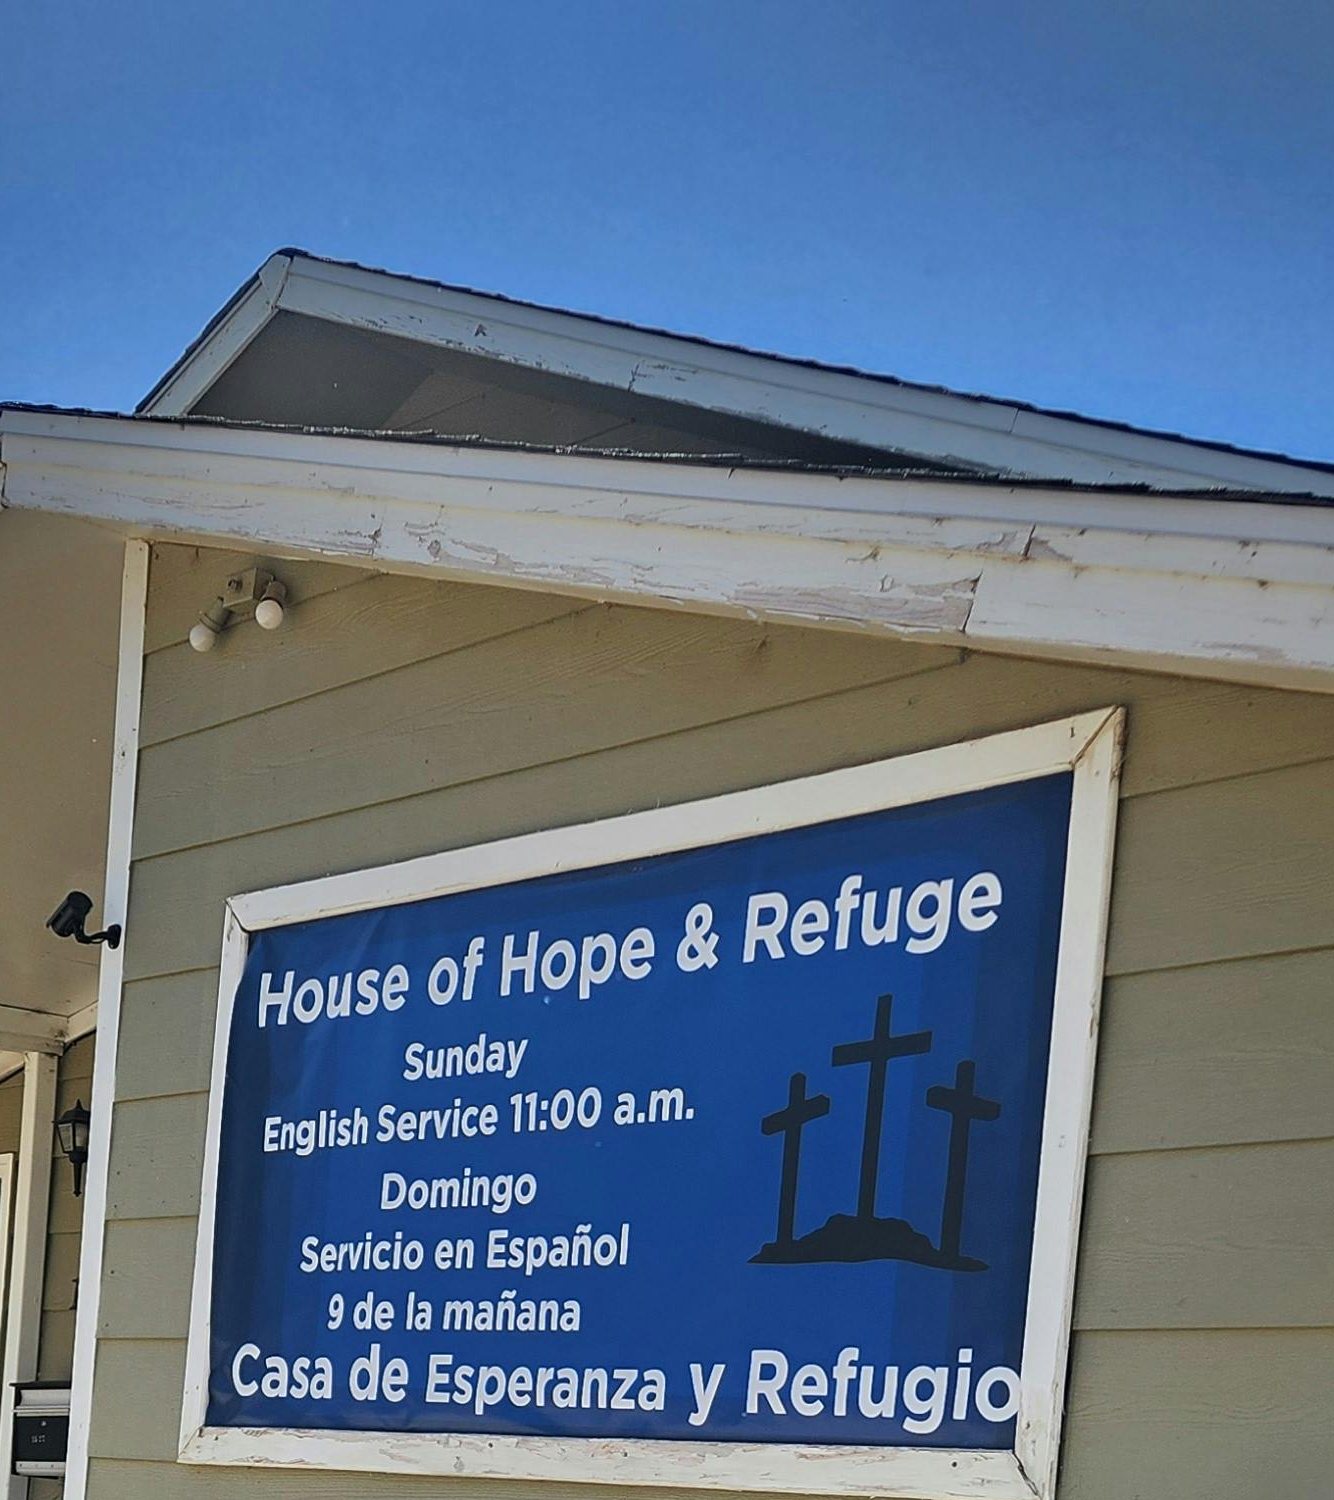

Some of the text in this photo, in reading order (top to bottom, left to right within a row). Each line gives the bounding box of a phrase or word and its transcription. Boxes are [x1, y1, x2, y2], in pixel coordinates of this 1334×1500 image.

[259, 873, 1001, 1027] House of Hope & Refuge
[404, 1034, 528, 1080] Sunday
[264, 1088, 694, 1155] English Service 11:00 a.m.
[381, 1168, 536, 1213] Domingo
[301, 1224, 629, 1272] Servicio en Español
[328, 1290, 580, 1331] 9 de la mañana
[233, 1344, 1020, 1433] Casa de Esperanza y Refugio
